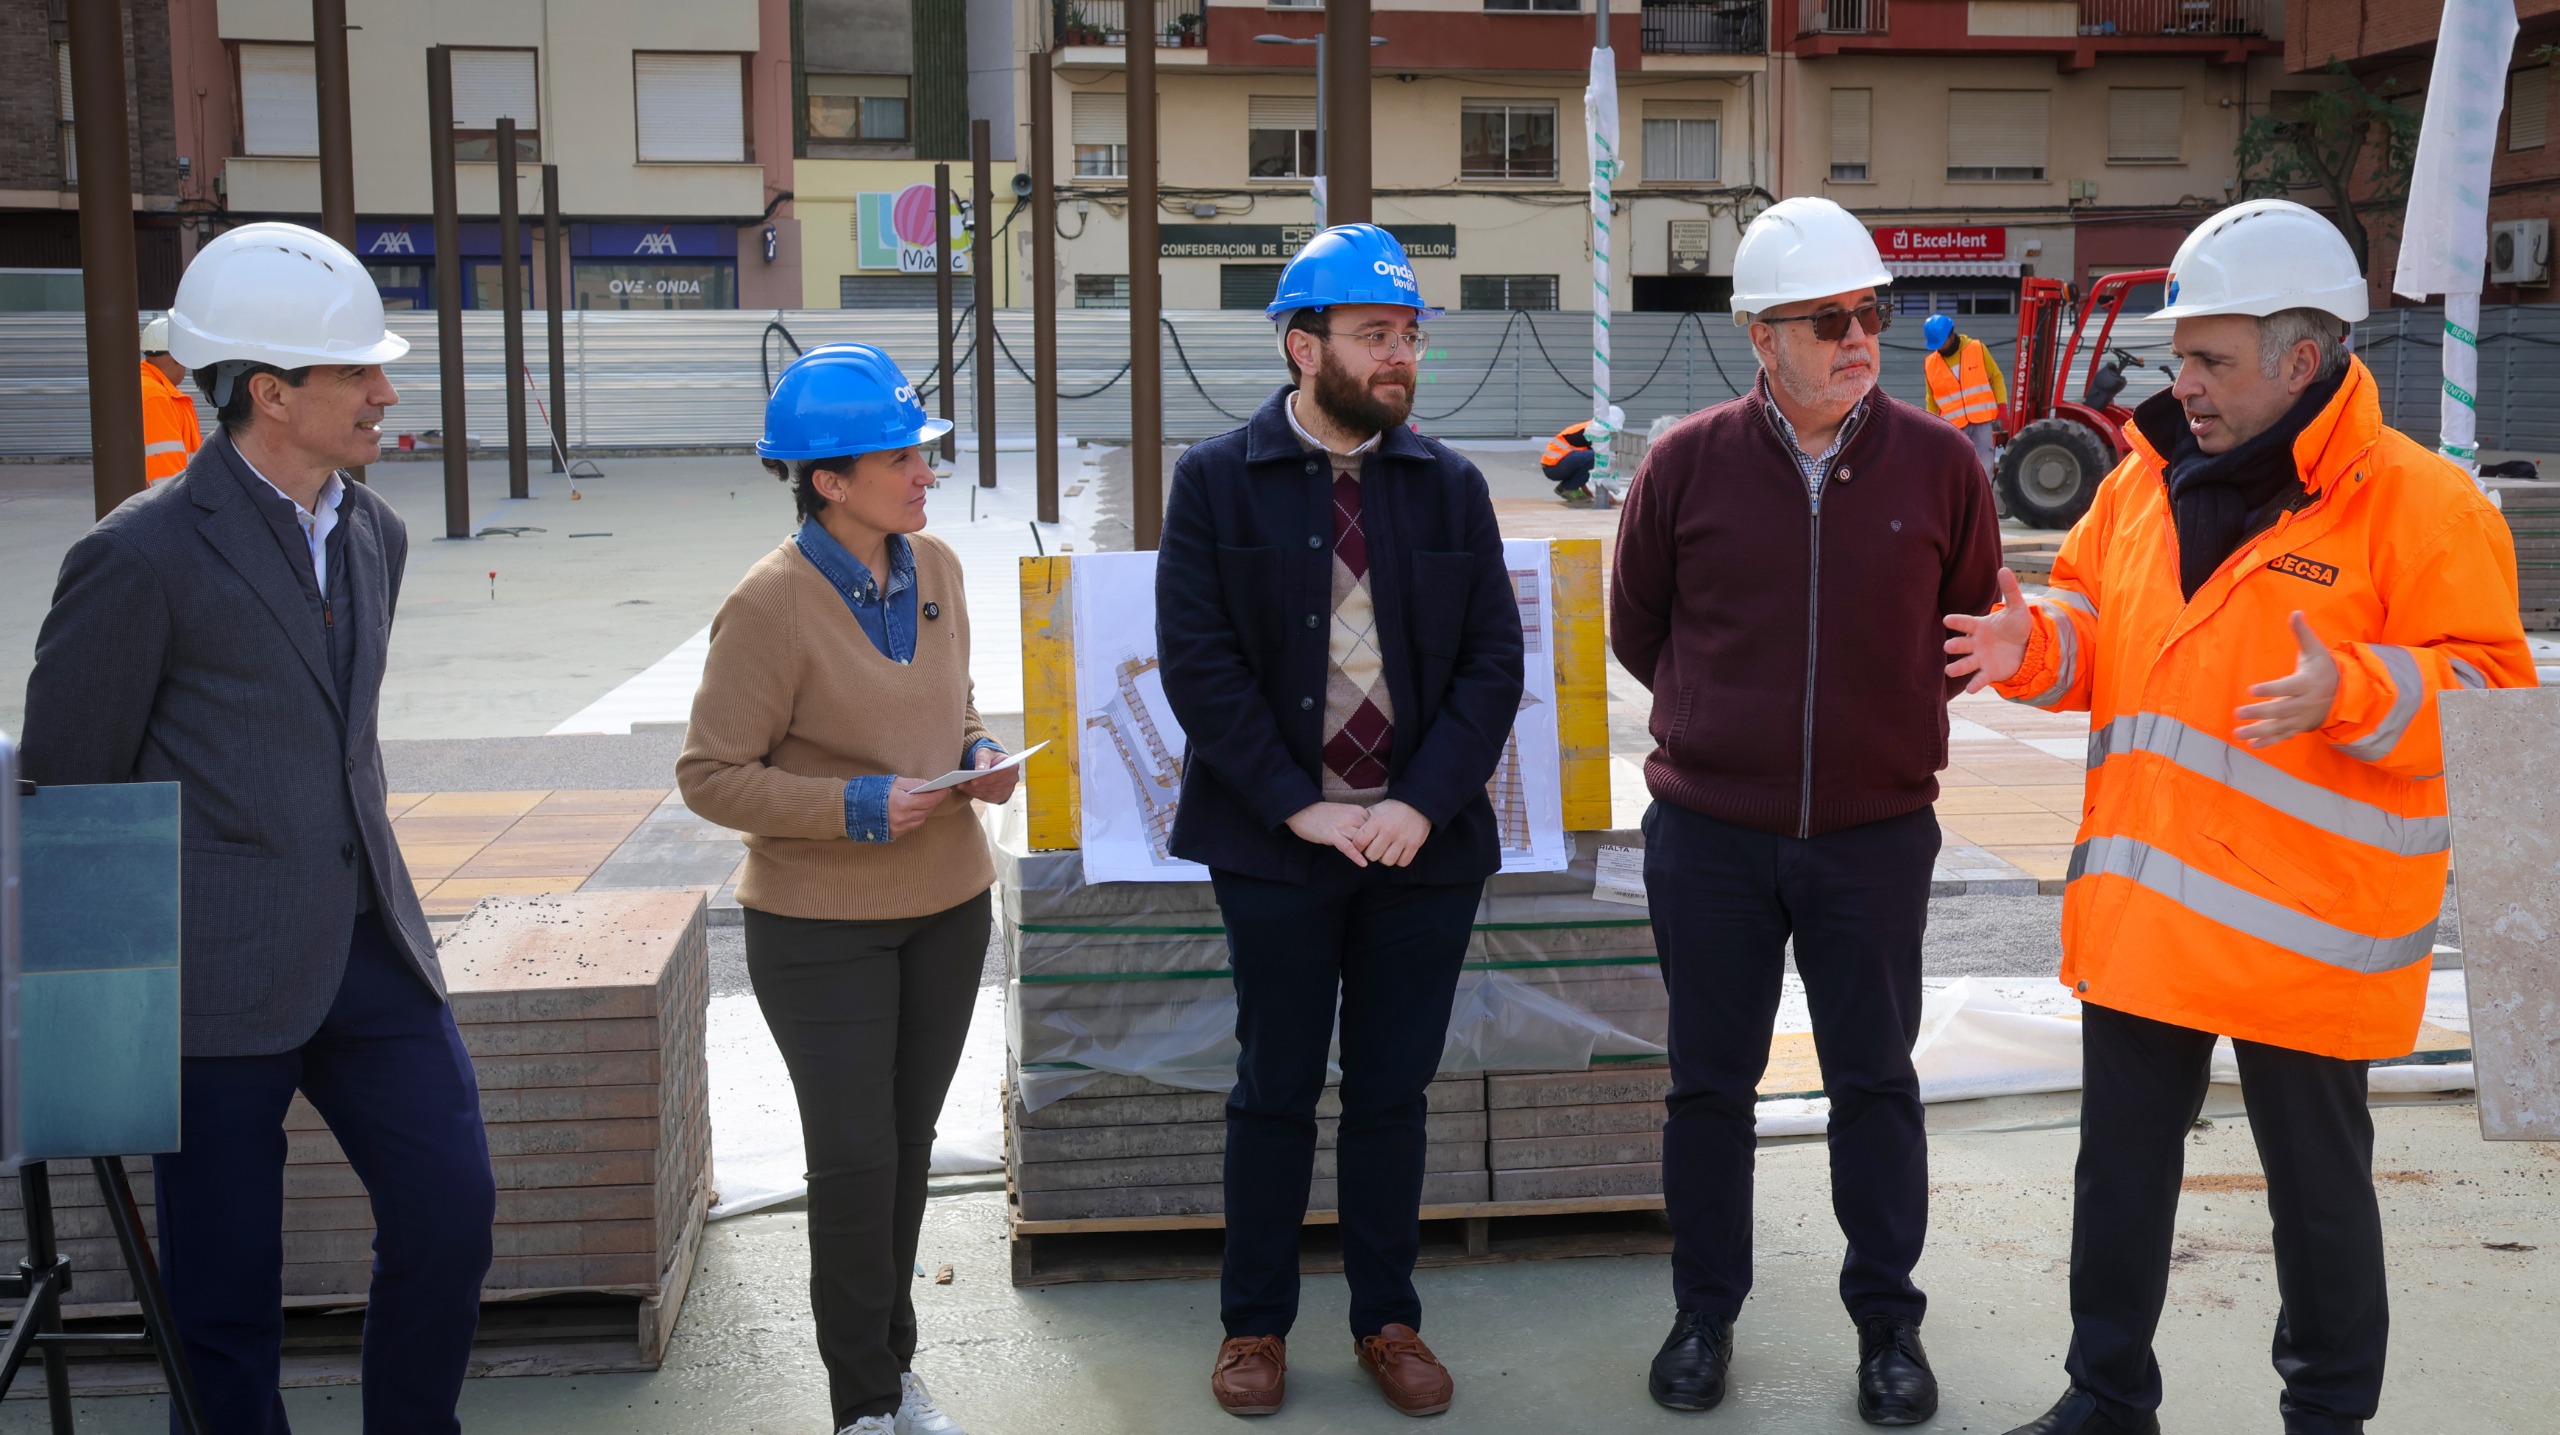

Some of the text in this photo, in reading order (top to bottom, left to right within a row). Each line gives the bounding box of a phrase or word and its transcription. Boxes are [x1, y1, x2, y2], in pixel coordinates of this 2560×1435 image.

[369, 231, 415, 253] AXA
[633, 232, 677, 254] AXA
[1282, 226, 1315, 243] CE
[1160, 243, 1256, 256] CONFEDERACION
[1262, 243, 1277, 256] DE
[1402, 243, 1450, 256] STELLON
[1373, 261, 1415, 282] Onda
[609, 280, 645, 294] OVE
[656, 280, 700, 294] ONDA
[2271, 554, 2334, 585] BECSA
